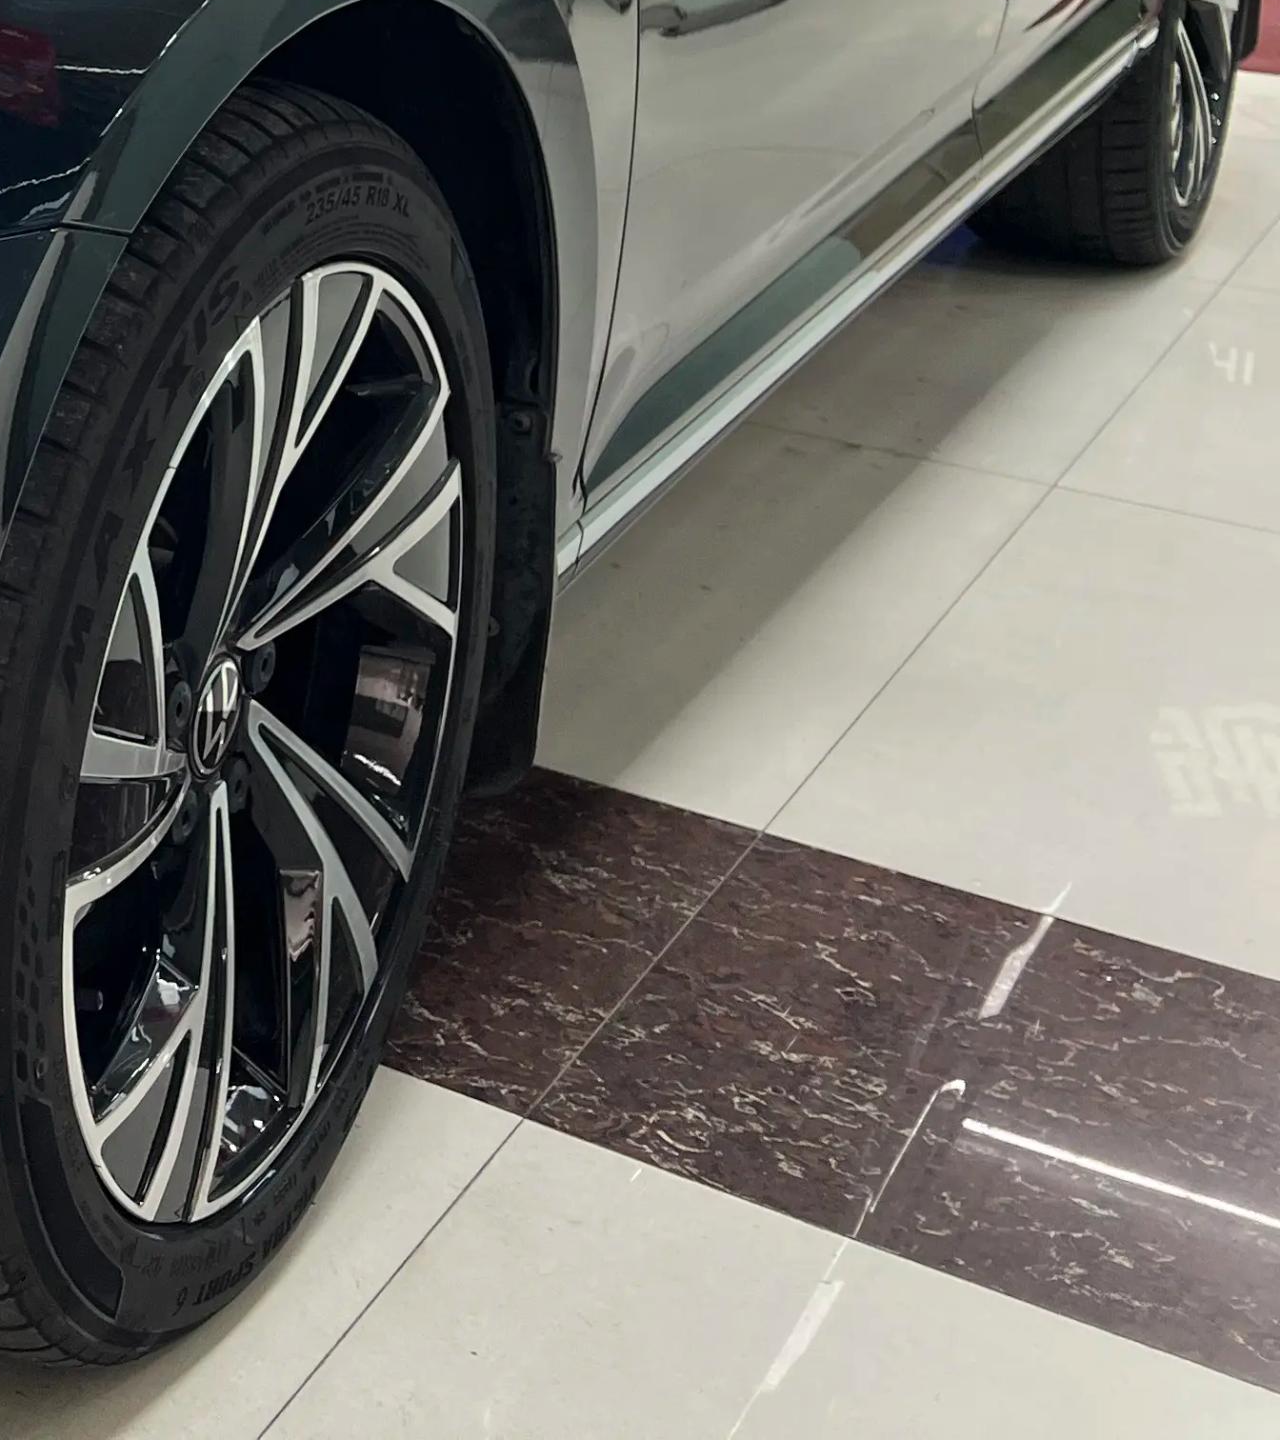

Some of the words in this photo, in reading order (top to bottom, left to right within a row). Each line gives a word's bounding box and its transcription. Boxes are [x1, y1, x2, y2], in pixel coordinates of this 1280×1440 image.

[305, 184, 362, 226] 235/45
[365, 185, 391, 208] R18
[392, 191, 410, 218] XL
